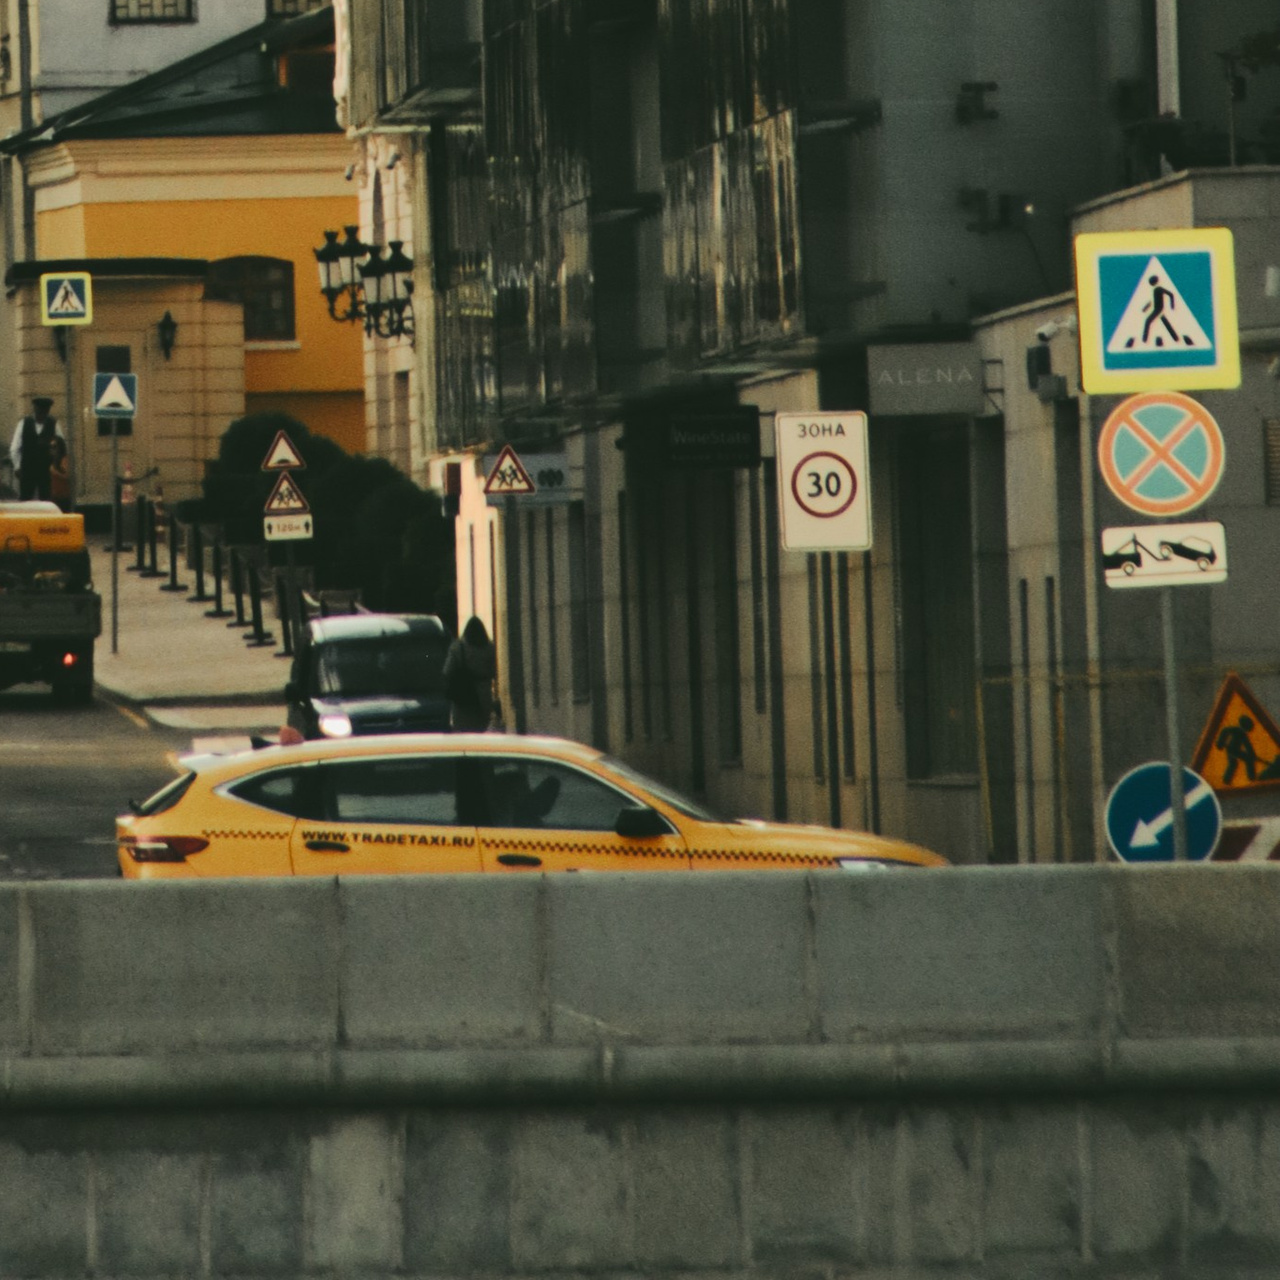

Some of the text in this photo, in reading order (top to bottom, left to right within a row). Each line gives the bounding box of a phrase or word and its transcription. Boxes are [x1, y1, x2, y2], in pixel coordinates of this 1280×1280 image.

[878, 366, 973, 386] ALENA
[798, 423, 846, 438] ЗОНА
[807, 471, 841, 498] 30
[302, 830, 475, 848] WWW.TRADETAXI.RU
